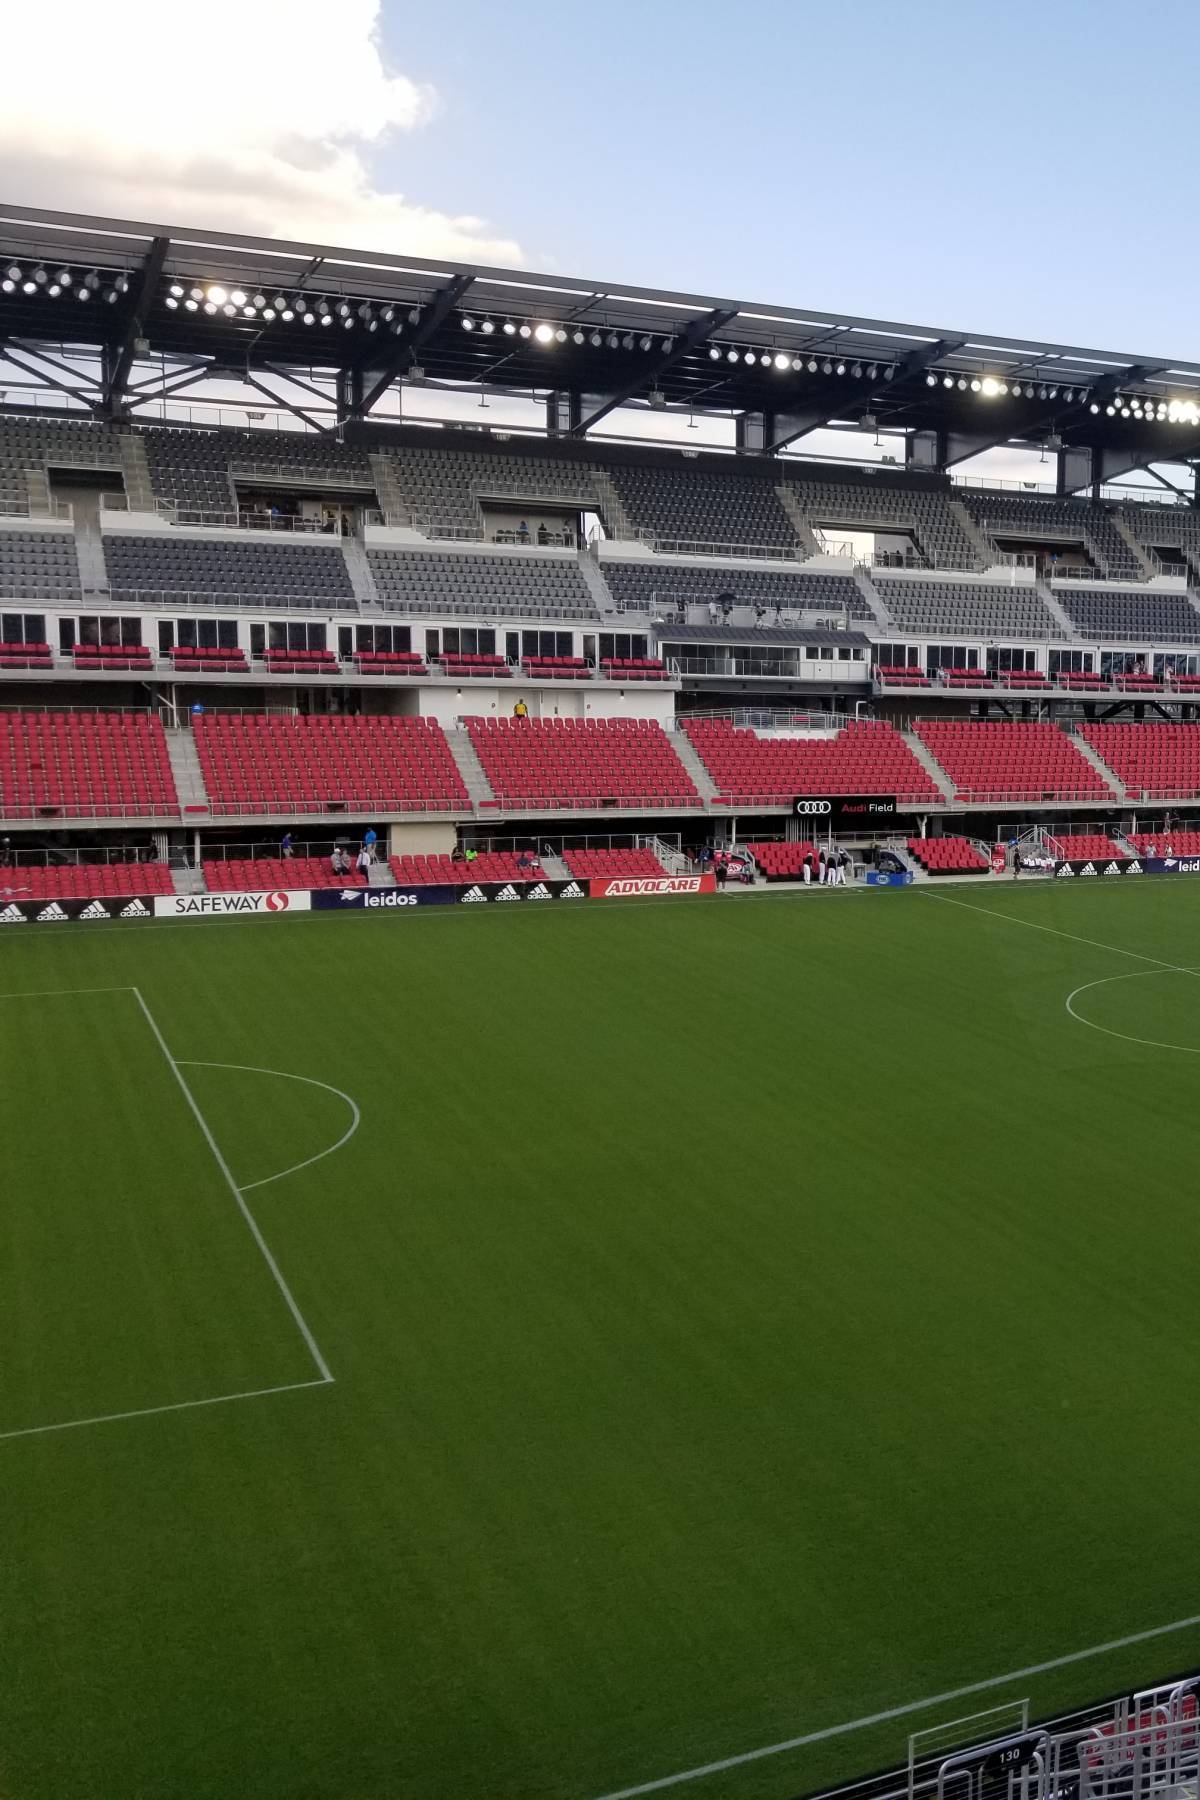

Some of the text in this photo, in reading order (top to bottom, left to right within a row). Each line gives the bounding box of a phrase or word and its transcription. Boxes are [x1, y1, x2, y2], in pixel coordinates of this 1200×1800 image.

[841, 803, 893, 812] Audi Field
[606, 878, 700, 896] ADVOCARE
[175, 895, 263, 913] SAFEWAY
[364, 892, 417, 907] leidos
[0, 914, 28, 922] didas
[79, 911, 111, 919] adidas
[1000, 1749, 1020, 1763] 130
